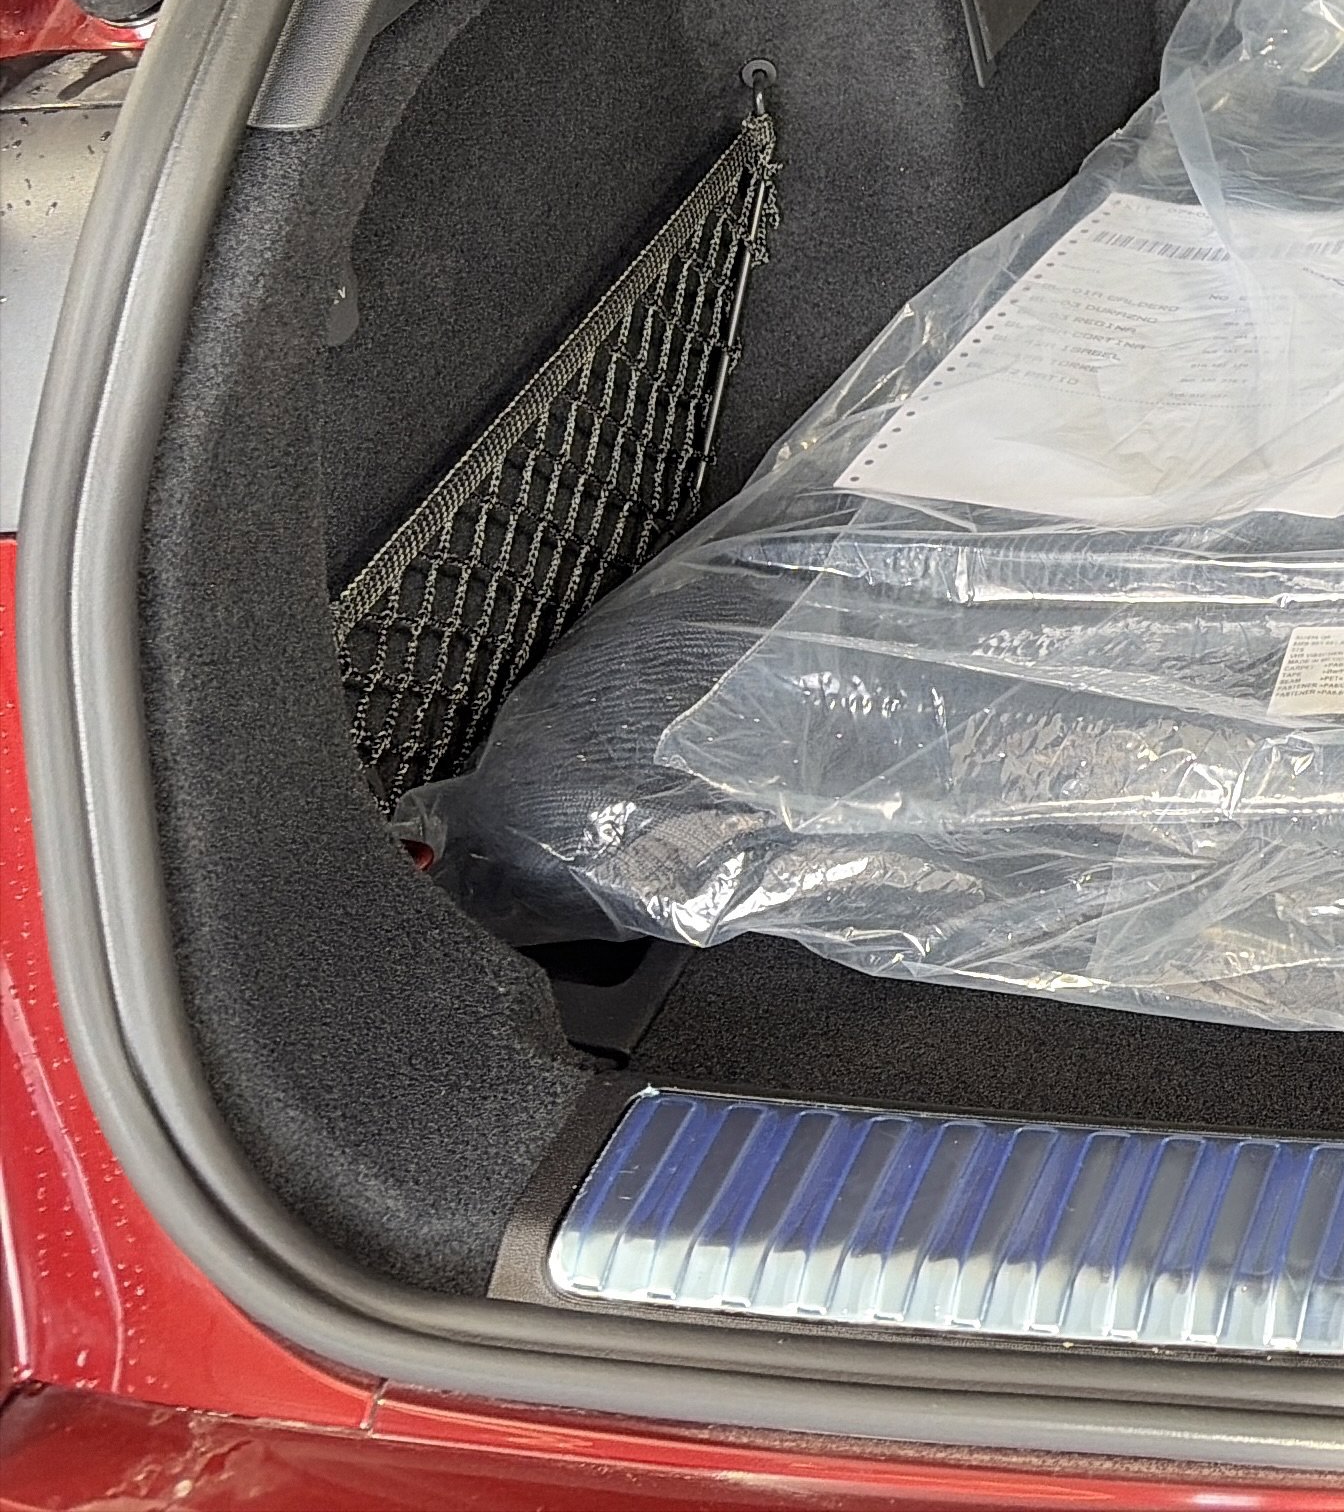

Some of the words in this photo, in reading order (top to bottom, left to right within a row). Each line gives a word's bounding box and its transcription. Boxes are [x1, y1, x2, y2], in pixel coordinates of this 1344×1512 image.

[1073, 316, 1137, 334] REGINA
[1072, 331, 1146, 350] CORTINA
[1061, 345, 1121, 361] ISABEL
